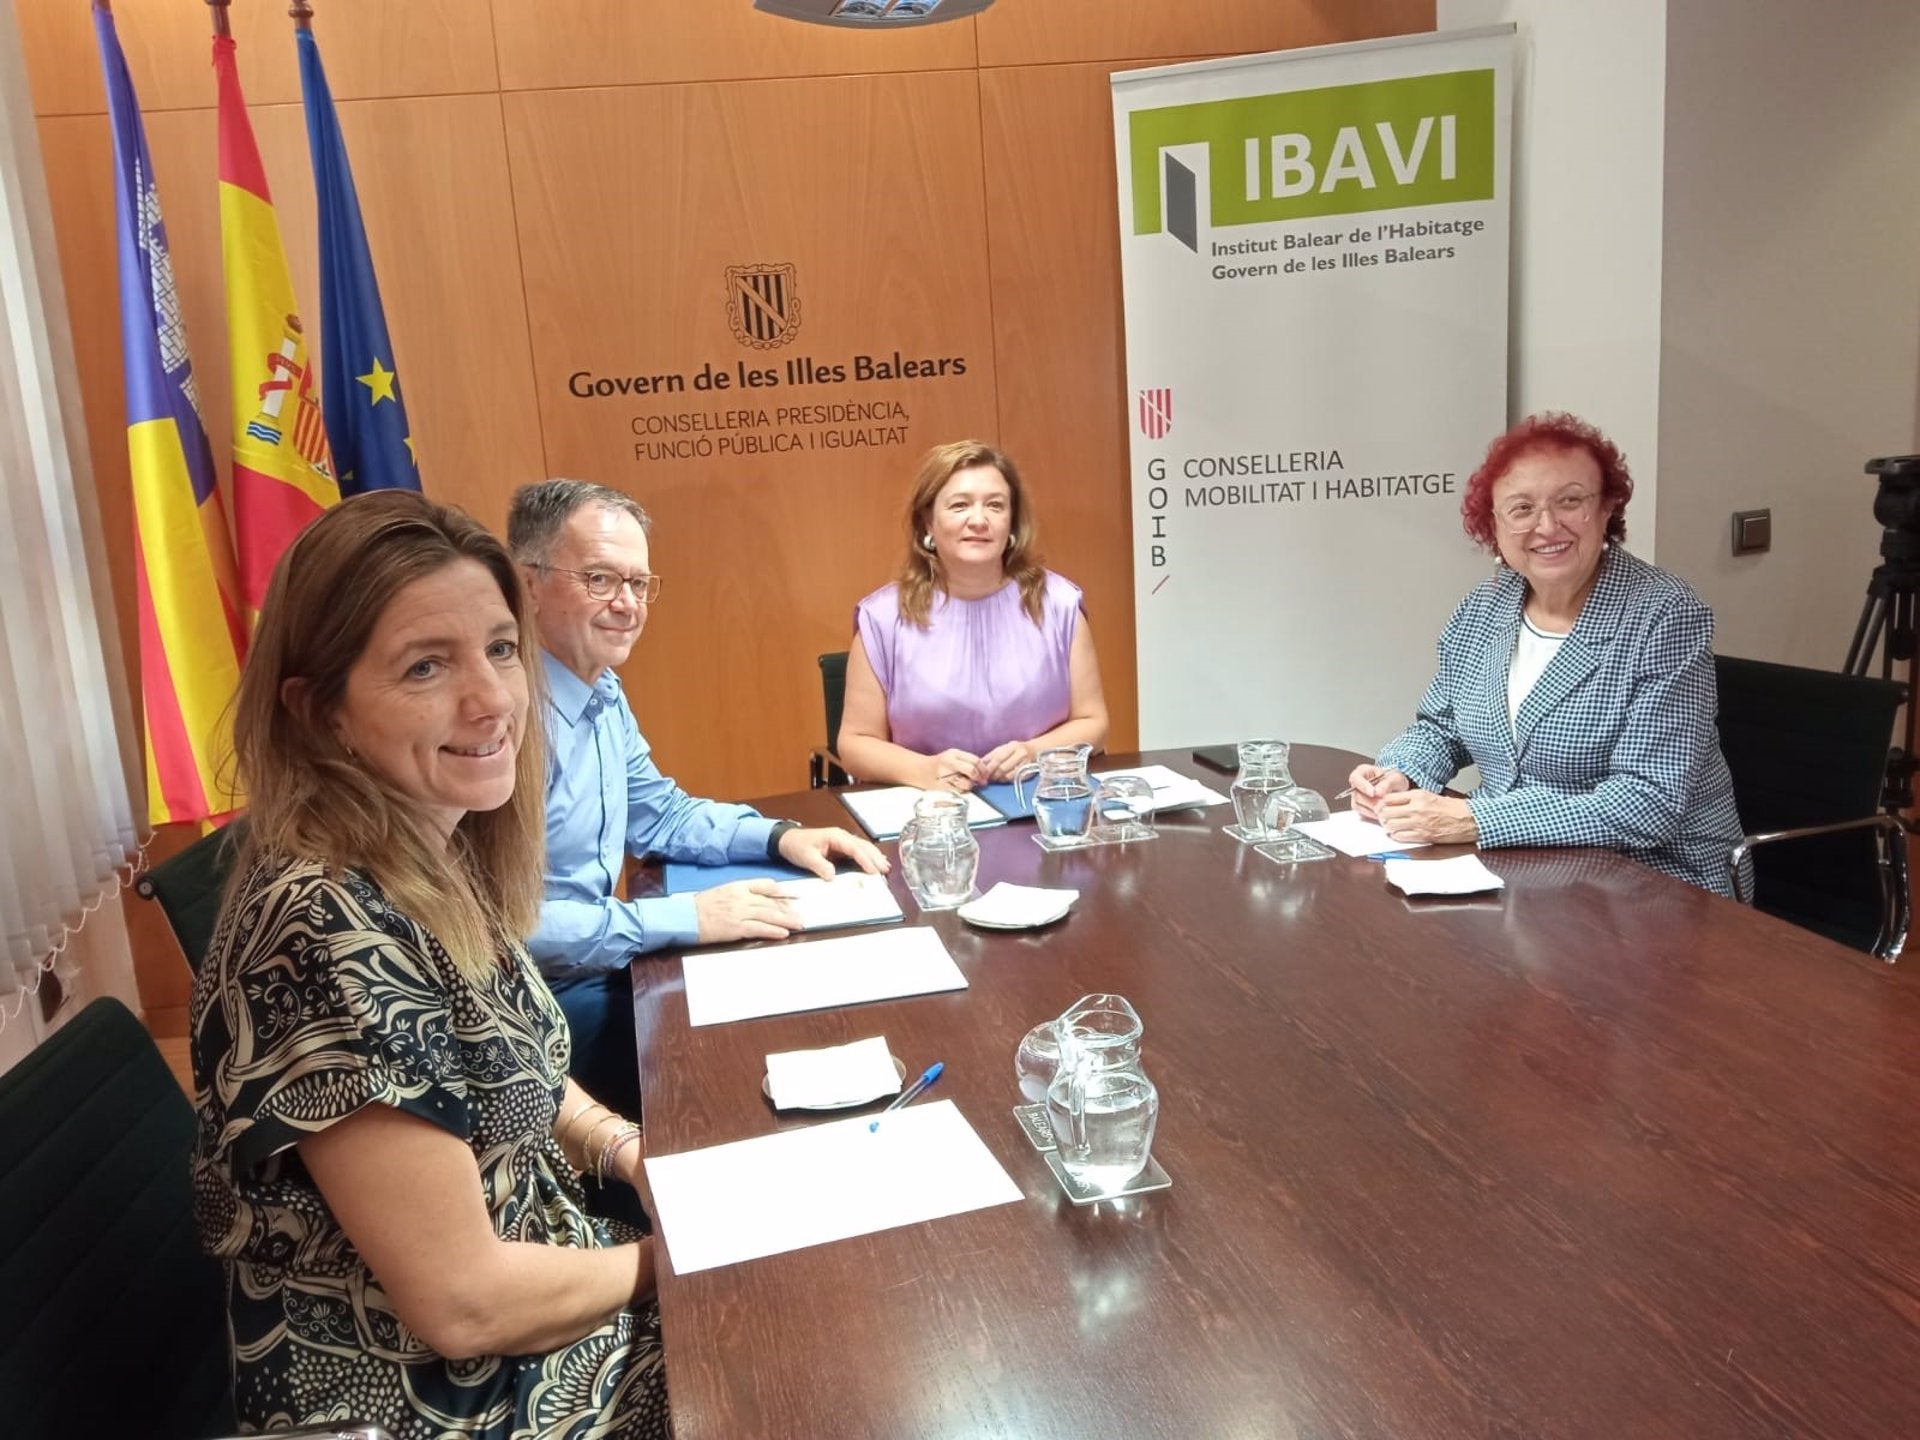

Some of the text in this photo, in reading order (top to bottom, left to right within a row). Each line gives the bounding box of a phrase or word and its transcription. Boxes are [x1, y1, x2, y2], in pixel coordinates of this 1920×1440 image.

[1245, 115, 1456, 201] IBAVI
[1212, 218, 1484, 257] Institut Balear de l'Habitatge
[1212, 246, 1455, 280] Govern de les Illes Balears
[569, 351, 967, 398] Govern de les Illes Balears
[631, 399, 910, 436] CONSELLERIA PRESIDÈNCIA,
[634, 435, 712, 461] FUNCIÓ
[719, 430, 801, 456] PÚBLICA
[820, 426, 909, 449] IGUALTAT
[1183, 450, 1344, 479] CONSELLERIA
[1185, 482, 1306, 507] MOBILITAT
[1325, 473, 1456, 499] HABITATGE
